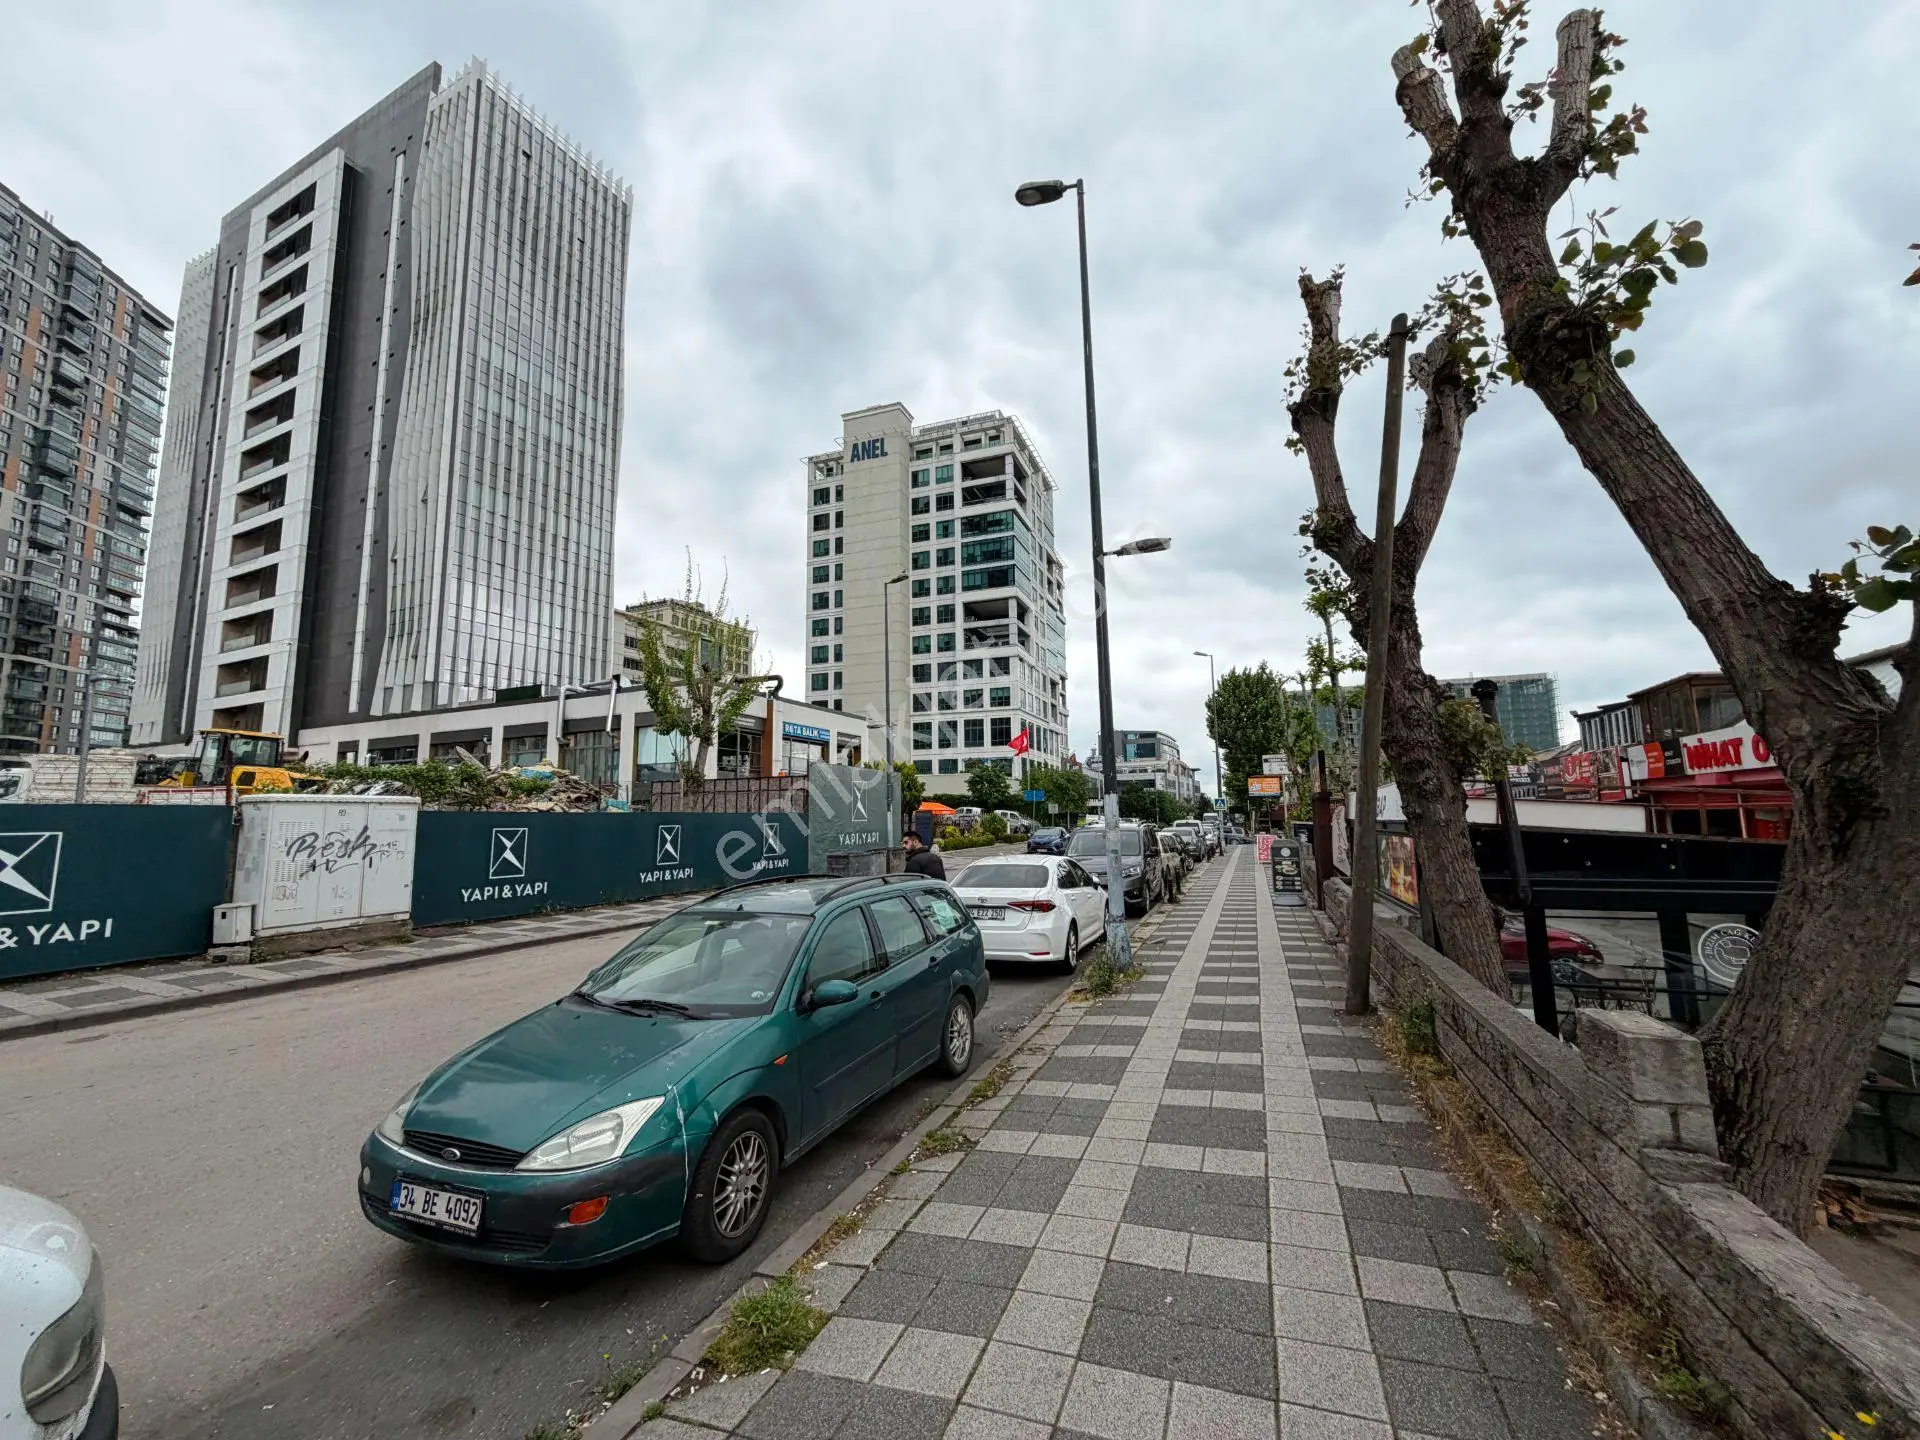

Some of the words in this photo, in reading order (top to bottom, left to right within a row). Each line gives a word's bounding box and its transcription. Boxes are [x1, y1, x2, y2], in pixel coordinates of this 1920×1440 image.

[851, 437, 888, 462] ANEL
[839, 832, 859, 845] YAPI
[862, 832, 879, 844] YAPI
[640, 870, 663, 883] YAPI
[664, 869, 672, 880] &
[673, 867, 694, 879] YAPI
[752, 861, 768, 871] YAPI
[775, 859, 789, 868] YAPI
[461, 885, 499, 902] YAPI
[502, 884, 513, 898] &
[515, 881, 548, 896] YAPI
[26, 918, 113, 945] YAPI
[400, 1186, 416, 1210] 34
[422, 1190, 439, 1216] BE
[445, 1195, 479, 1226] 4092
